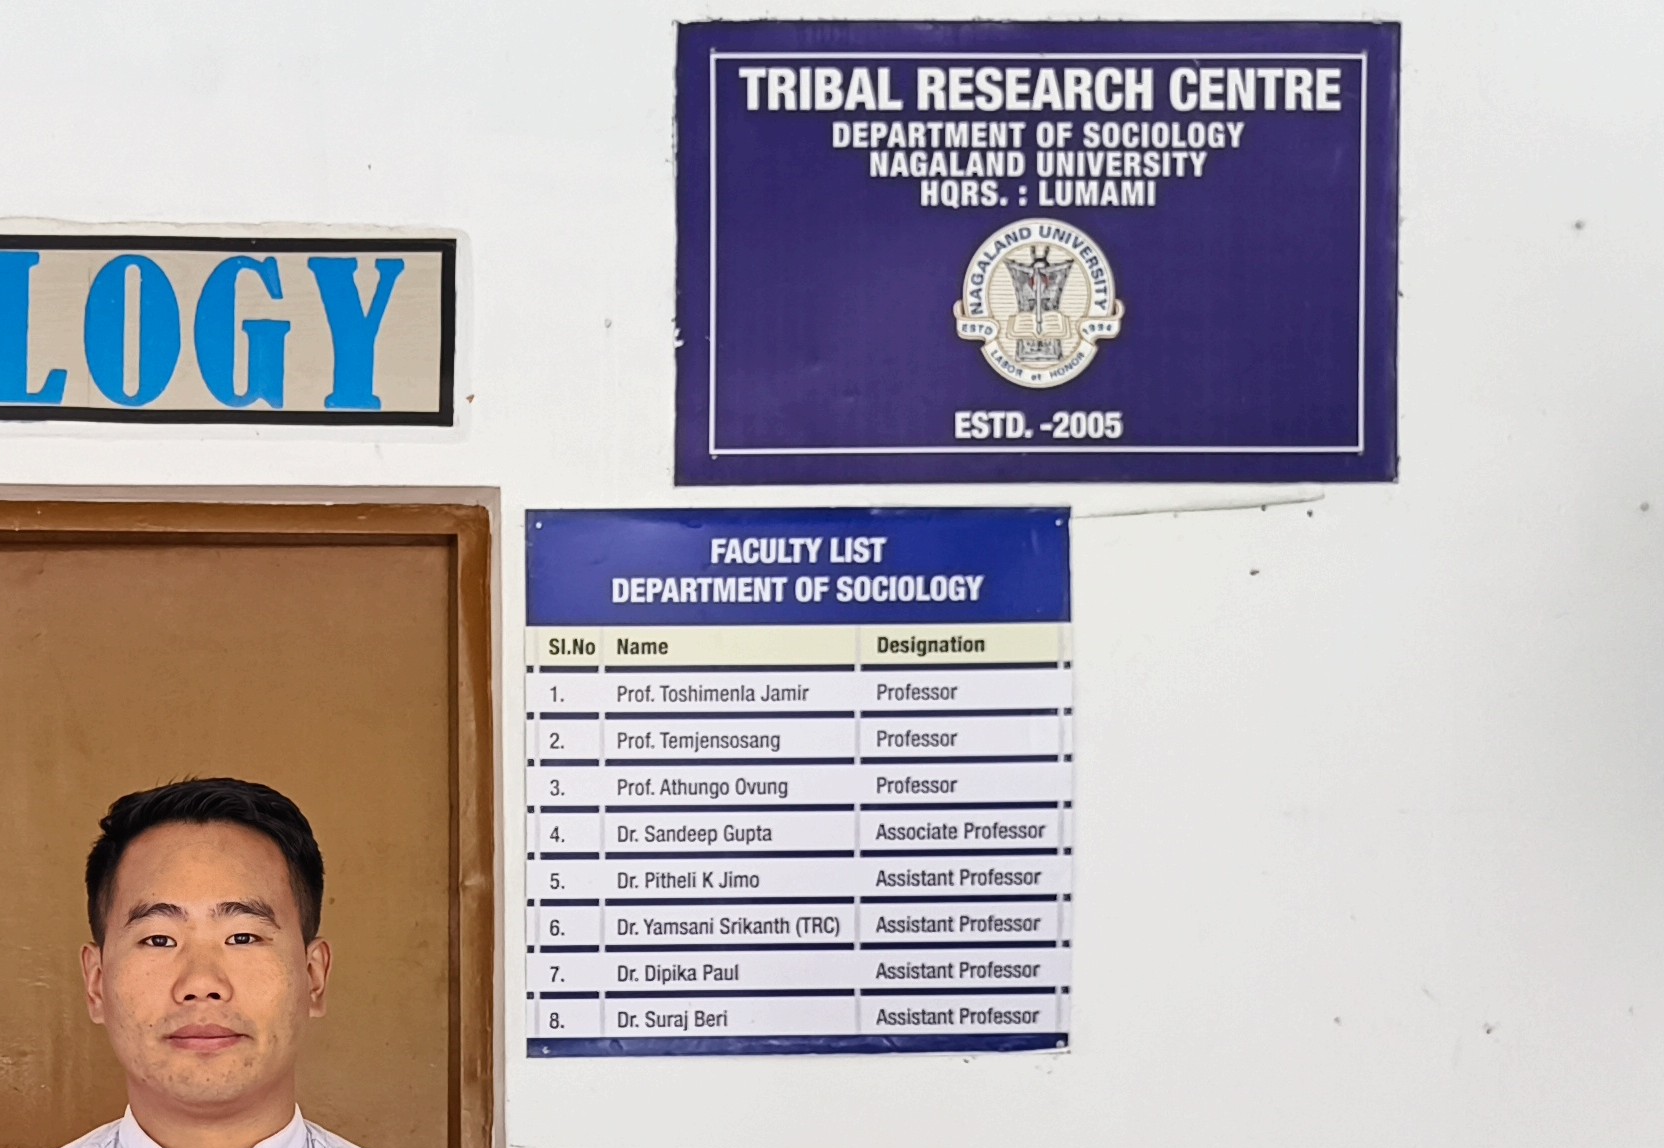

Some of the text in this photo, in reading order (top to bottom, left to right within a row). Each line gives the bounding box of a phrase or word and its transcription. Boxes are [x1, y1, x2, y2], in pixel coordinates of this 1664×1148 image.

[738, 66, 1342, 112] TRIBAL RESEARCH CENTRE
[832, 121, 1245, 149] DEPARTMENT OF SOCIOLOGY
[869, 150, 1207, 178] NAGALAND UNIVERSITY
[920, 179, 1008, 209] HQRS.
[1038, 179, 1156, 207] LUMAMI
[969, 226, 1108, 315] NAGALAND UNIVERSITY
[991, 349, 1023, 376] LABOR
[1050, 352, 1085, 379] HONOR
[954, 411, 1123, 439] ESTD. -2005
[710, 536, 887, 564] FACULTY LIST
[612, 575, 984, 603] DEPARTMENT OF SOCIOLOGY
[548, 638, 596, 656] Sl.No
[617, 638, 669, 655] Name
[877, 635, 985, 657] Designation
[549, 685, 565, 703] 1.
[617, 684, 810, 703] Prof. Toshimenla Jamir
[876, 683, 958, 701] Professor
[549, 732, 565, 750] 2.
[617, 731, 781, 753] Prof. Temjensosang
[876, 729, 958, 748] Professor
[549, 779, 565, 797] 3.
[617, 777, 788, 800] Prof. Athungo Ovung
[876, 776, 958, 794] Professor
[549, 825, 565, 843] 4.
[617, 824, 773, 846] Dr. Sandeep Gupta
[875, 821, 1046, 841] Associate Professor
[550, 872, 565, 890] 5.
[617, 871, 760, 889] Dr. Pitheli K Jimo
[875, 868, 1042, 887] Assistant Professor
[549, 919, 565, 937] 6.
[617, 916, 840, 938] Dr. Yamsani Srikanth (TRC)
[875, 914, 1042, 934] Assistant Professor
[549, 965, 565, 983] 7.
[617, 963, 739, 985] Dr. Dipika Paul
[875, 960, 1041, 980] Assistant Professor
[549, 1012, 565, 1030] 8.
[617, 1009, 728, 1032] Dr. Suraj Beri
[876, 1007, 1040, 1026] Assistant Professor
